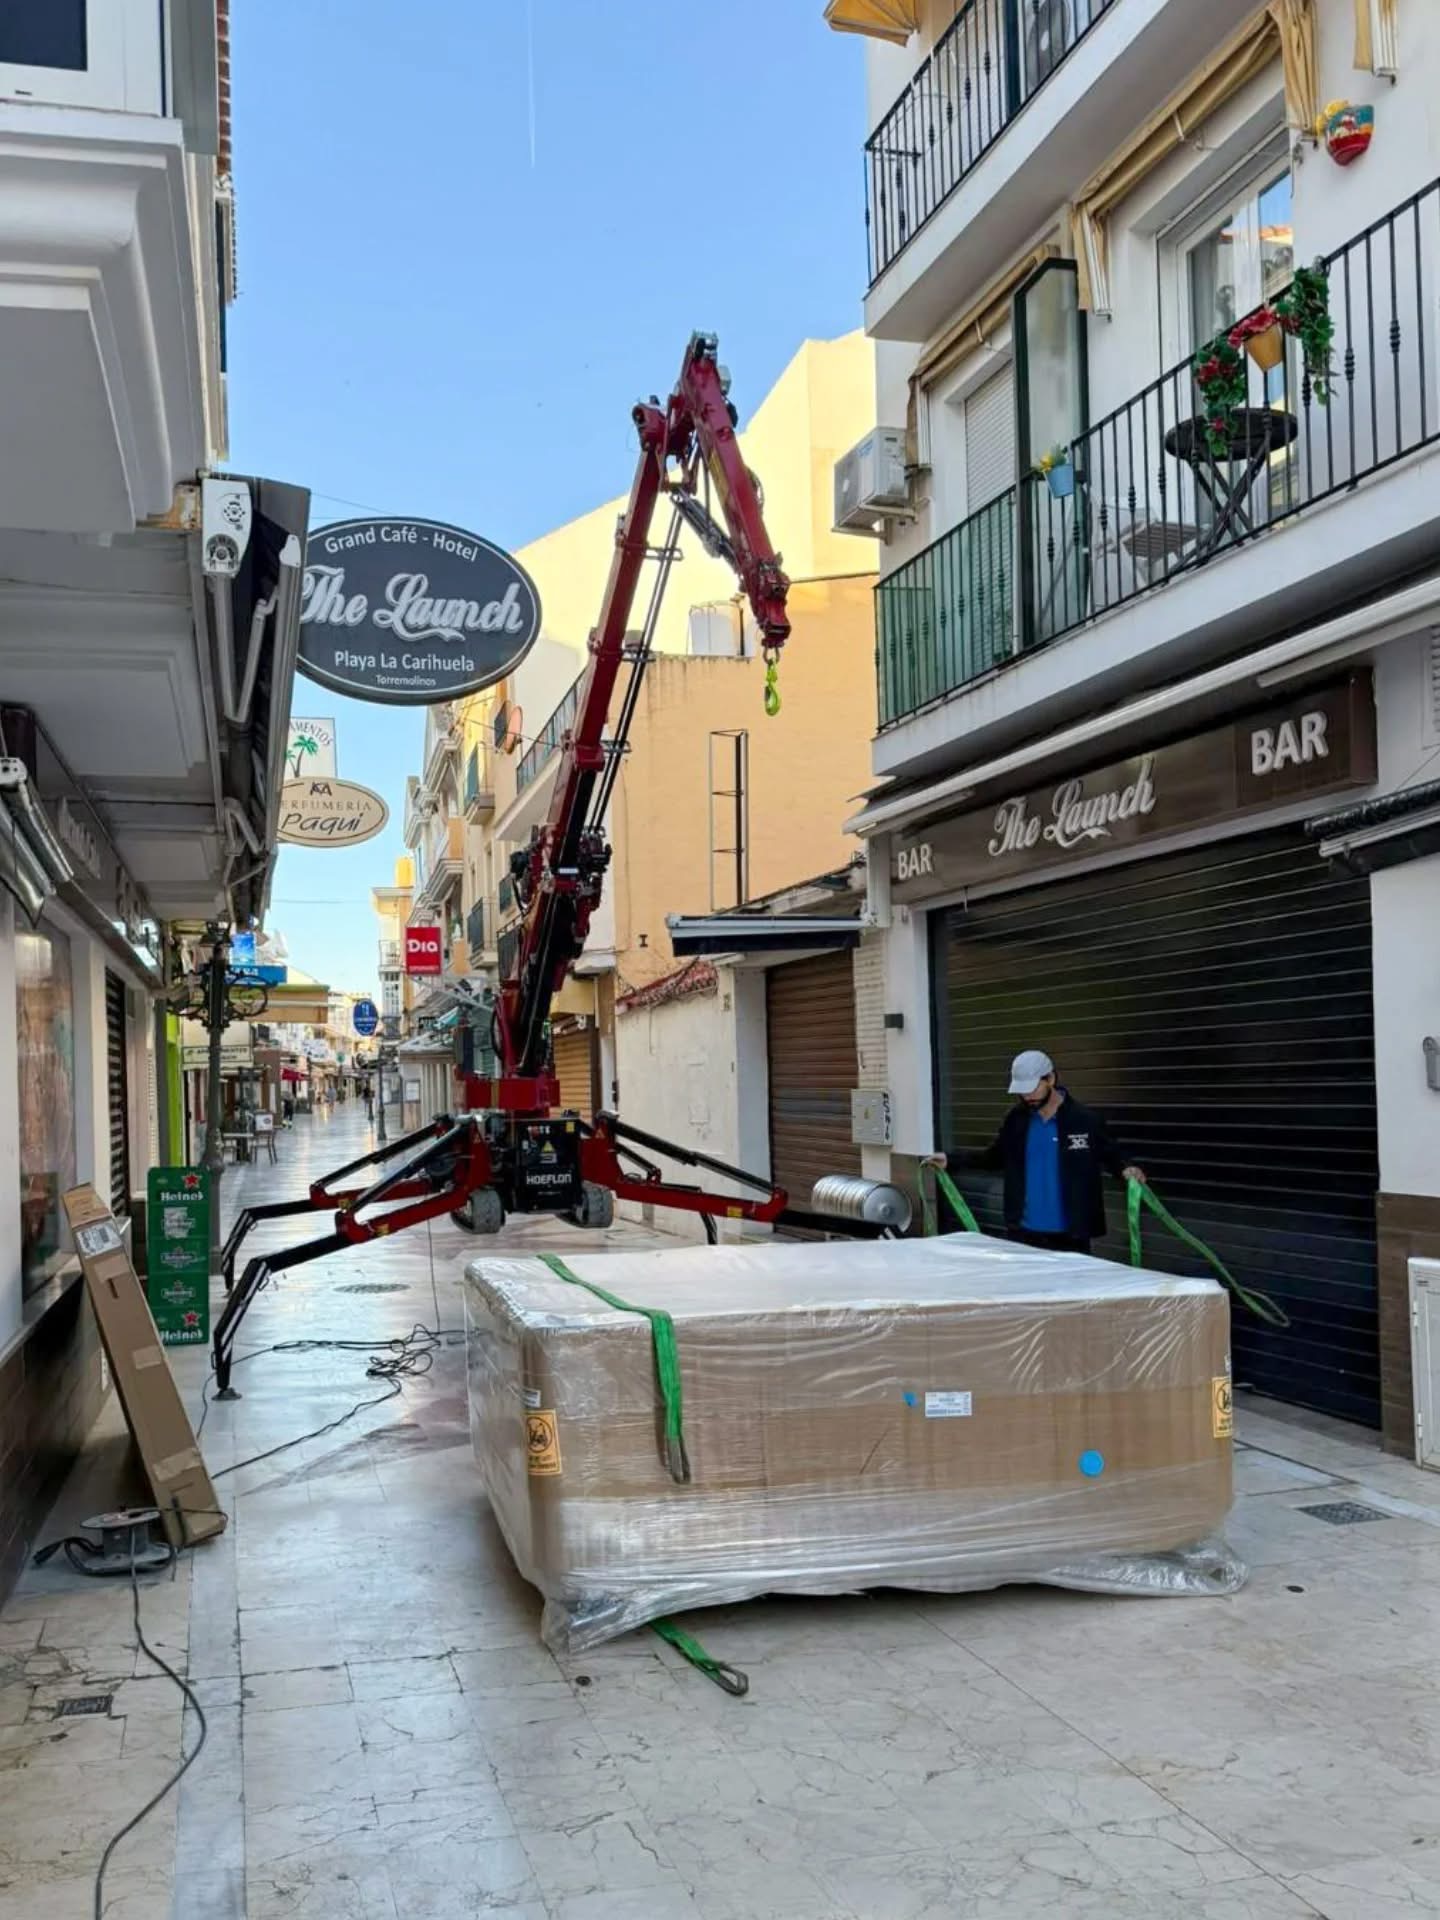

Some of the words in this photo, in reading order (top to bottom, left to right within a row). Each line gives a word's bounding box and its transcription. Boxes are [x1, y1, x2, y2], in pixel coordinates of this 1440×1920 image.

[325, 527, 376, 553] Grand
[381, 526, 418, 544] Café
[433, 532, 479, 562] Hotel
[300, 565, 369, 626] The
[373, 573, 523, 641] Launch
[335, 650, 377, 671] Playa
[381, 653, 398, 669] La
[402, 653, 475, 672] Carihuela
[375, 674, 437, 687] Torremolinos
[1251, 711, 1330, 777] BAR
[987, 794, 1040, 858] The
[1042, 754, 1157, 849] Launch
[897, 842, 935, 881] BAR
